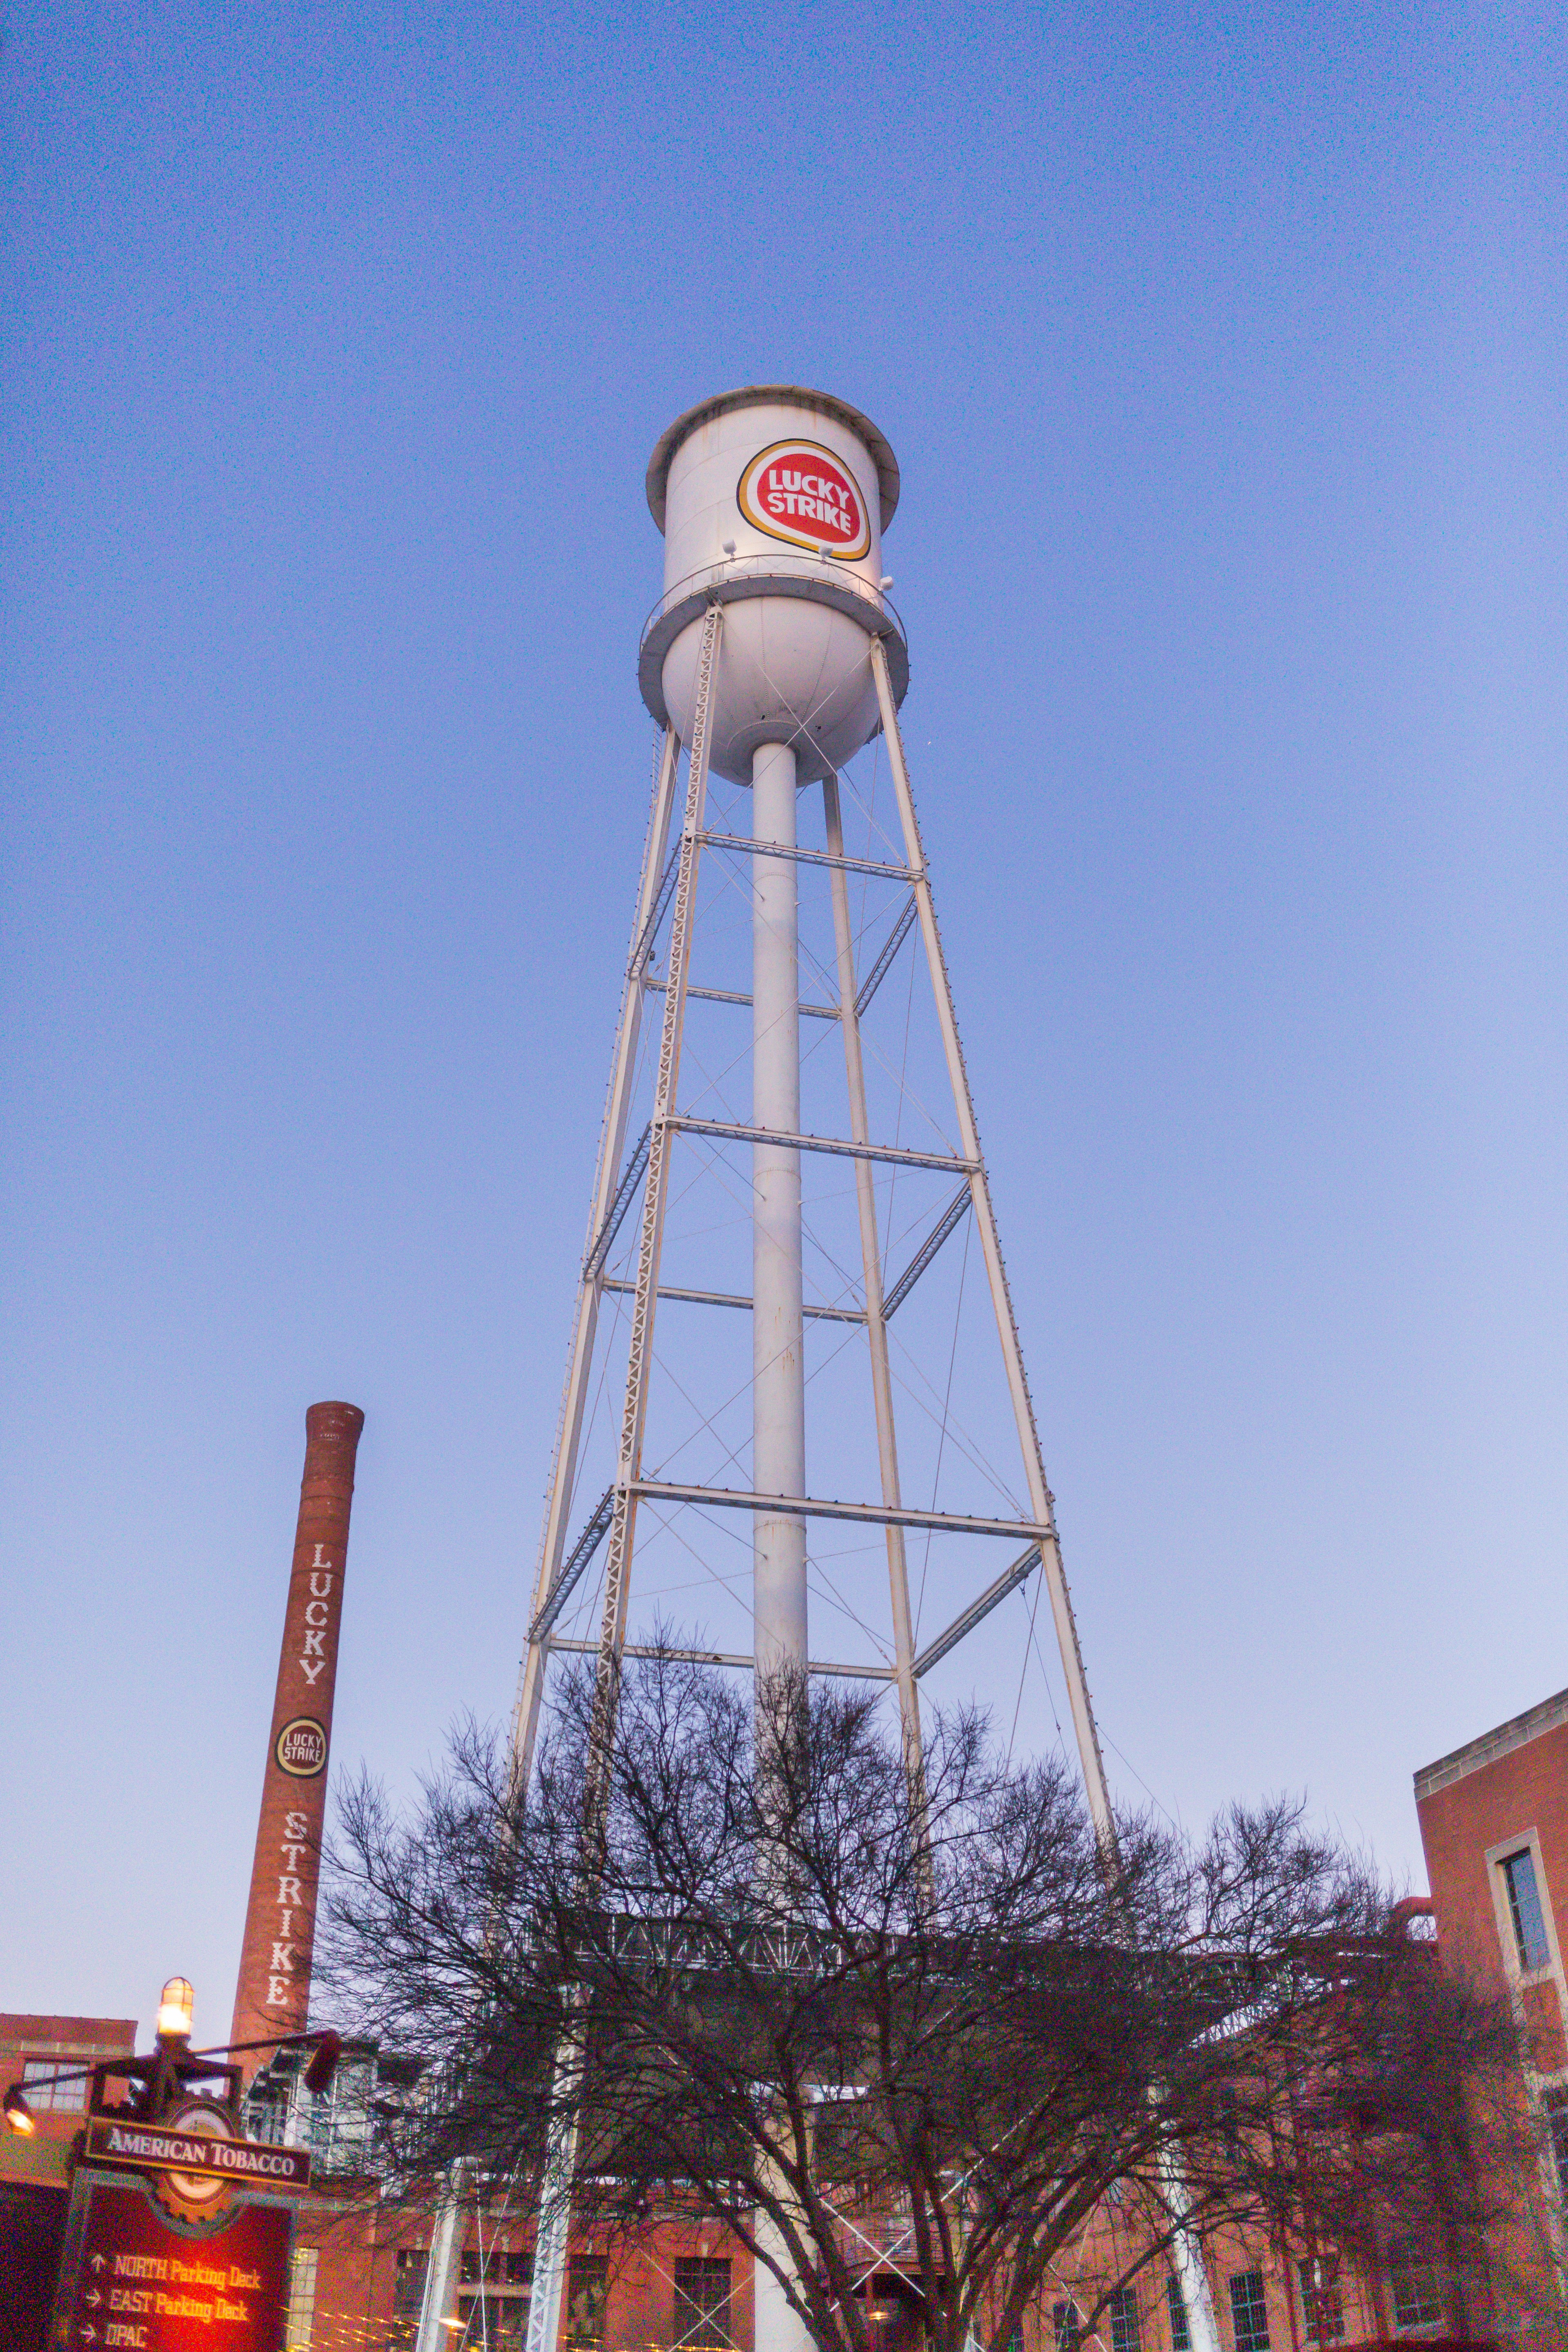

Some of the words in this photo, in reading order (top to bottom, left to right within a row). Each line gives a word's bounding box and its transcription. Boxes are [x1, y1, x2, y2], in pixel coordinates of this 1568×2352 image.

[769, 470, 850, 510] LUCKY
[767, 492, 851, 536] STRIKE
[299, 1544, 332, 1684] LUCKY
[284, 1747, 321, 1763] STRIKE
[286, 1734, 321, 1749] LUCKY
[266, 1812, 307, 2005] STRIKE
[107, 2127, 207, 2163] AMERICAN
[211, 2143, 295, 2176] TOBACCO
[114, 2255, 168, 2280] NORTH
[170, 2261, 225, 2290] Parking
[229, 2266, 261, 2288] Deck
[110, 2289, 153, 2313] EAST
[155, 2293, 212, 2323] Parking
[215, 2297, 248, 2321] Deck
